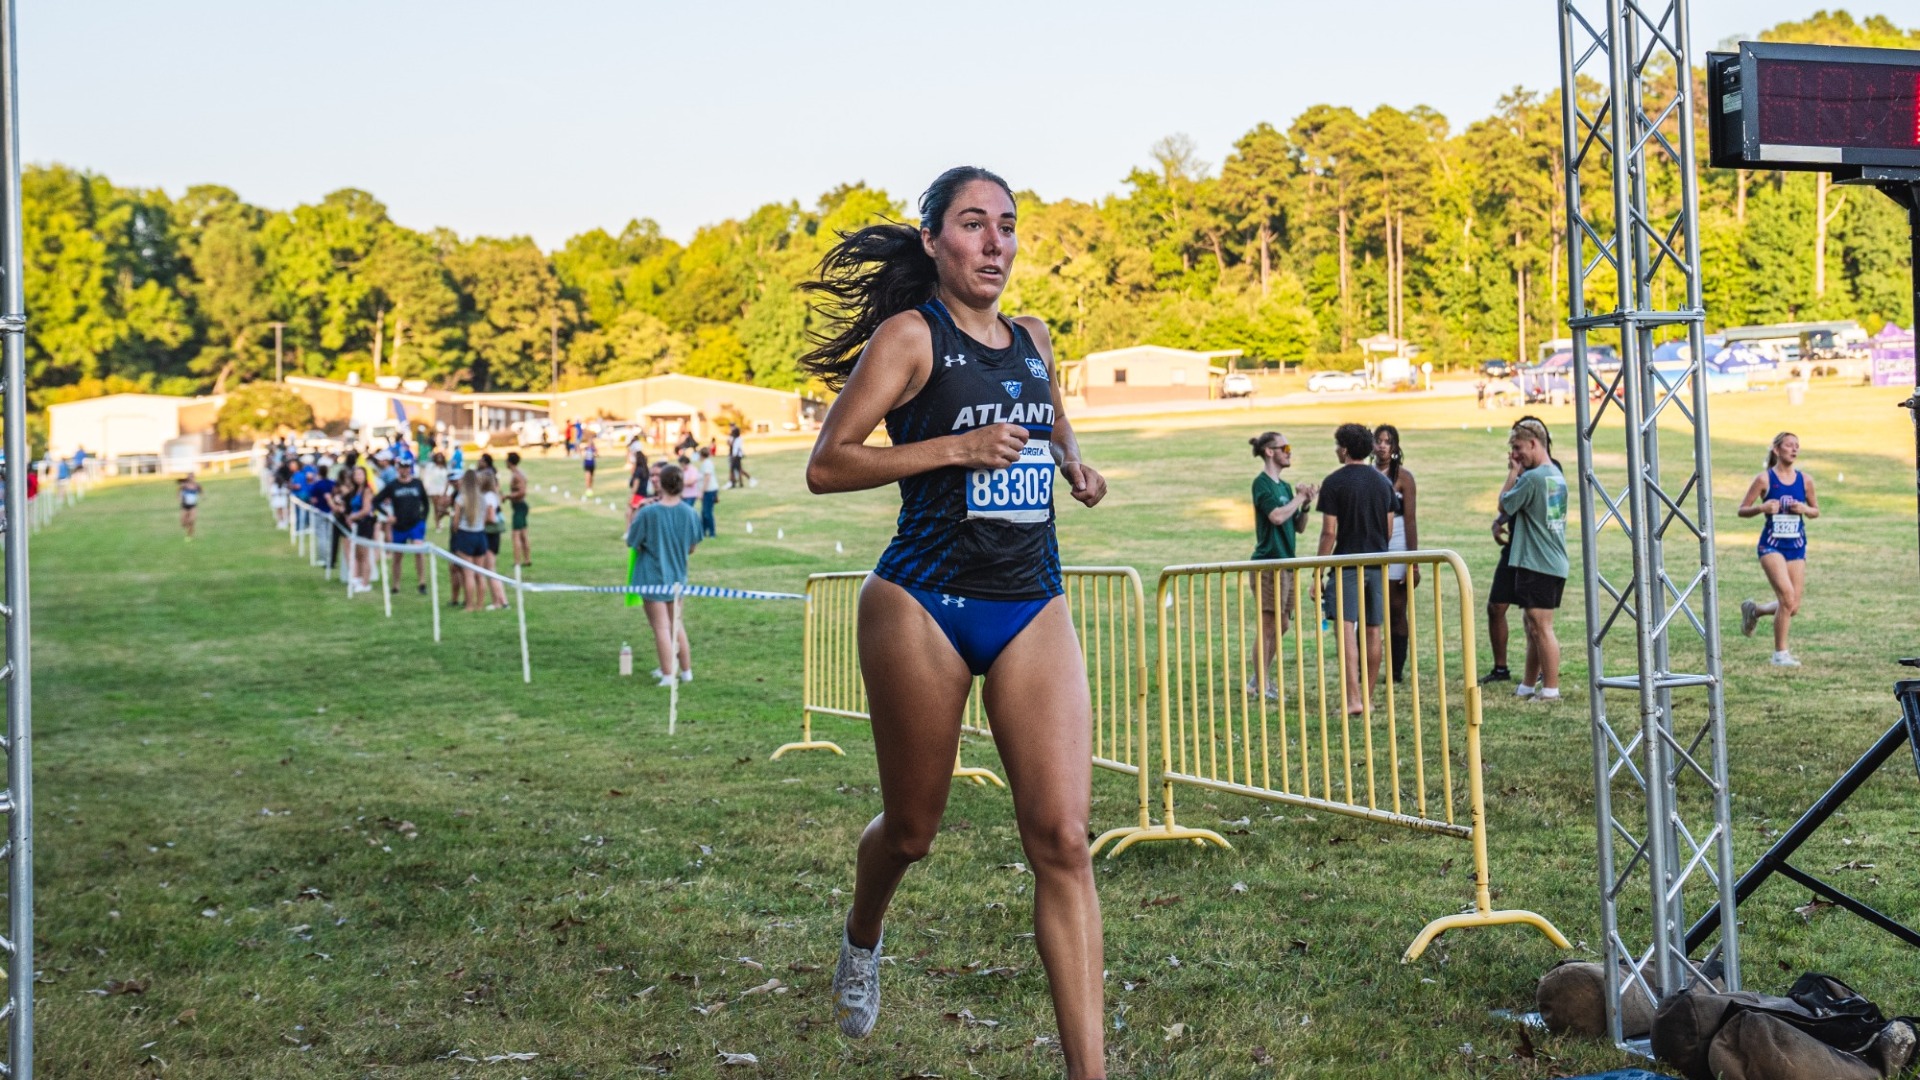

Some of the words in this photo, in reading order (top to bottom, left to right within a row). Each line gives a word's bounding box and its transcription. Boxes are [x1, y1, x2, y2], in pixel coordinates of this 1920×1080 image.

[951, 402, 1056, 431] ATLANT
[1019, 447, 1045, 456] ORGIA
[972, 467, 1052, 507] 83303
